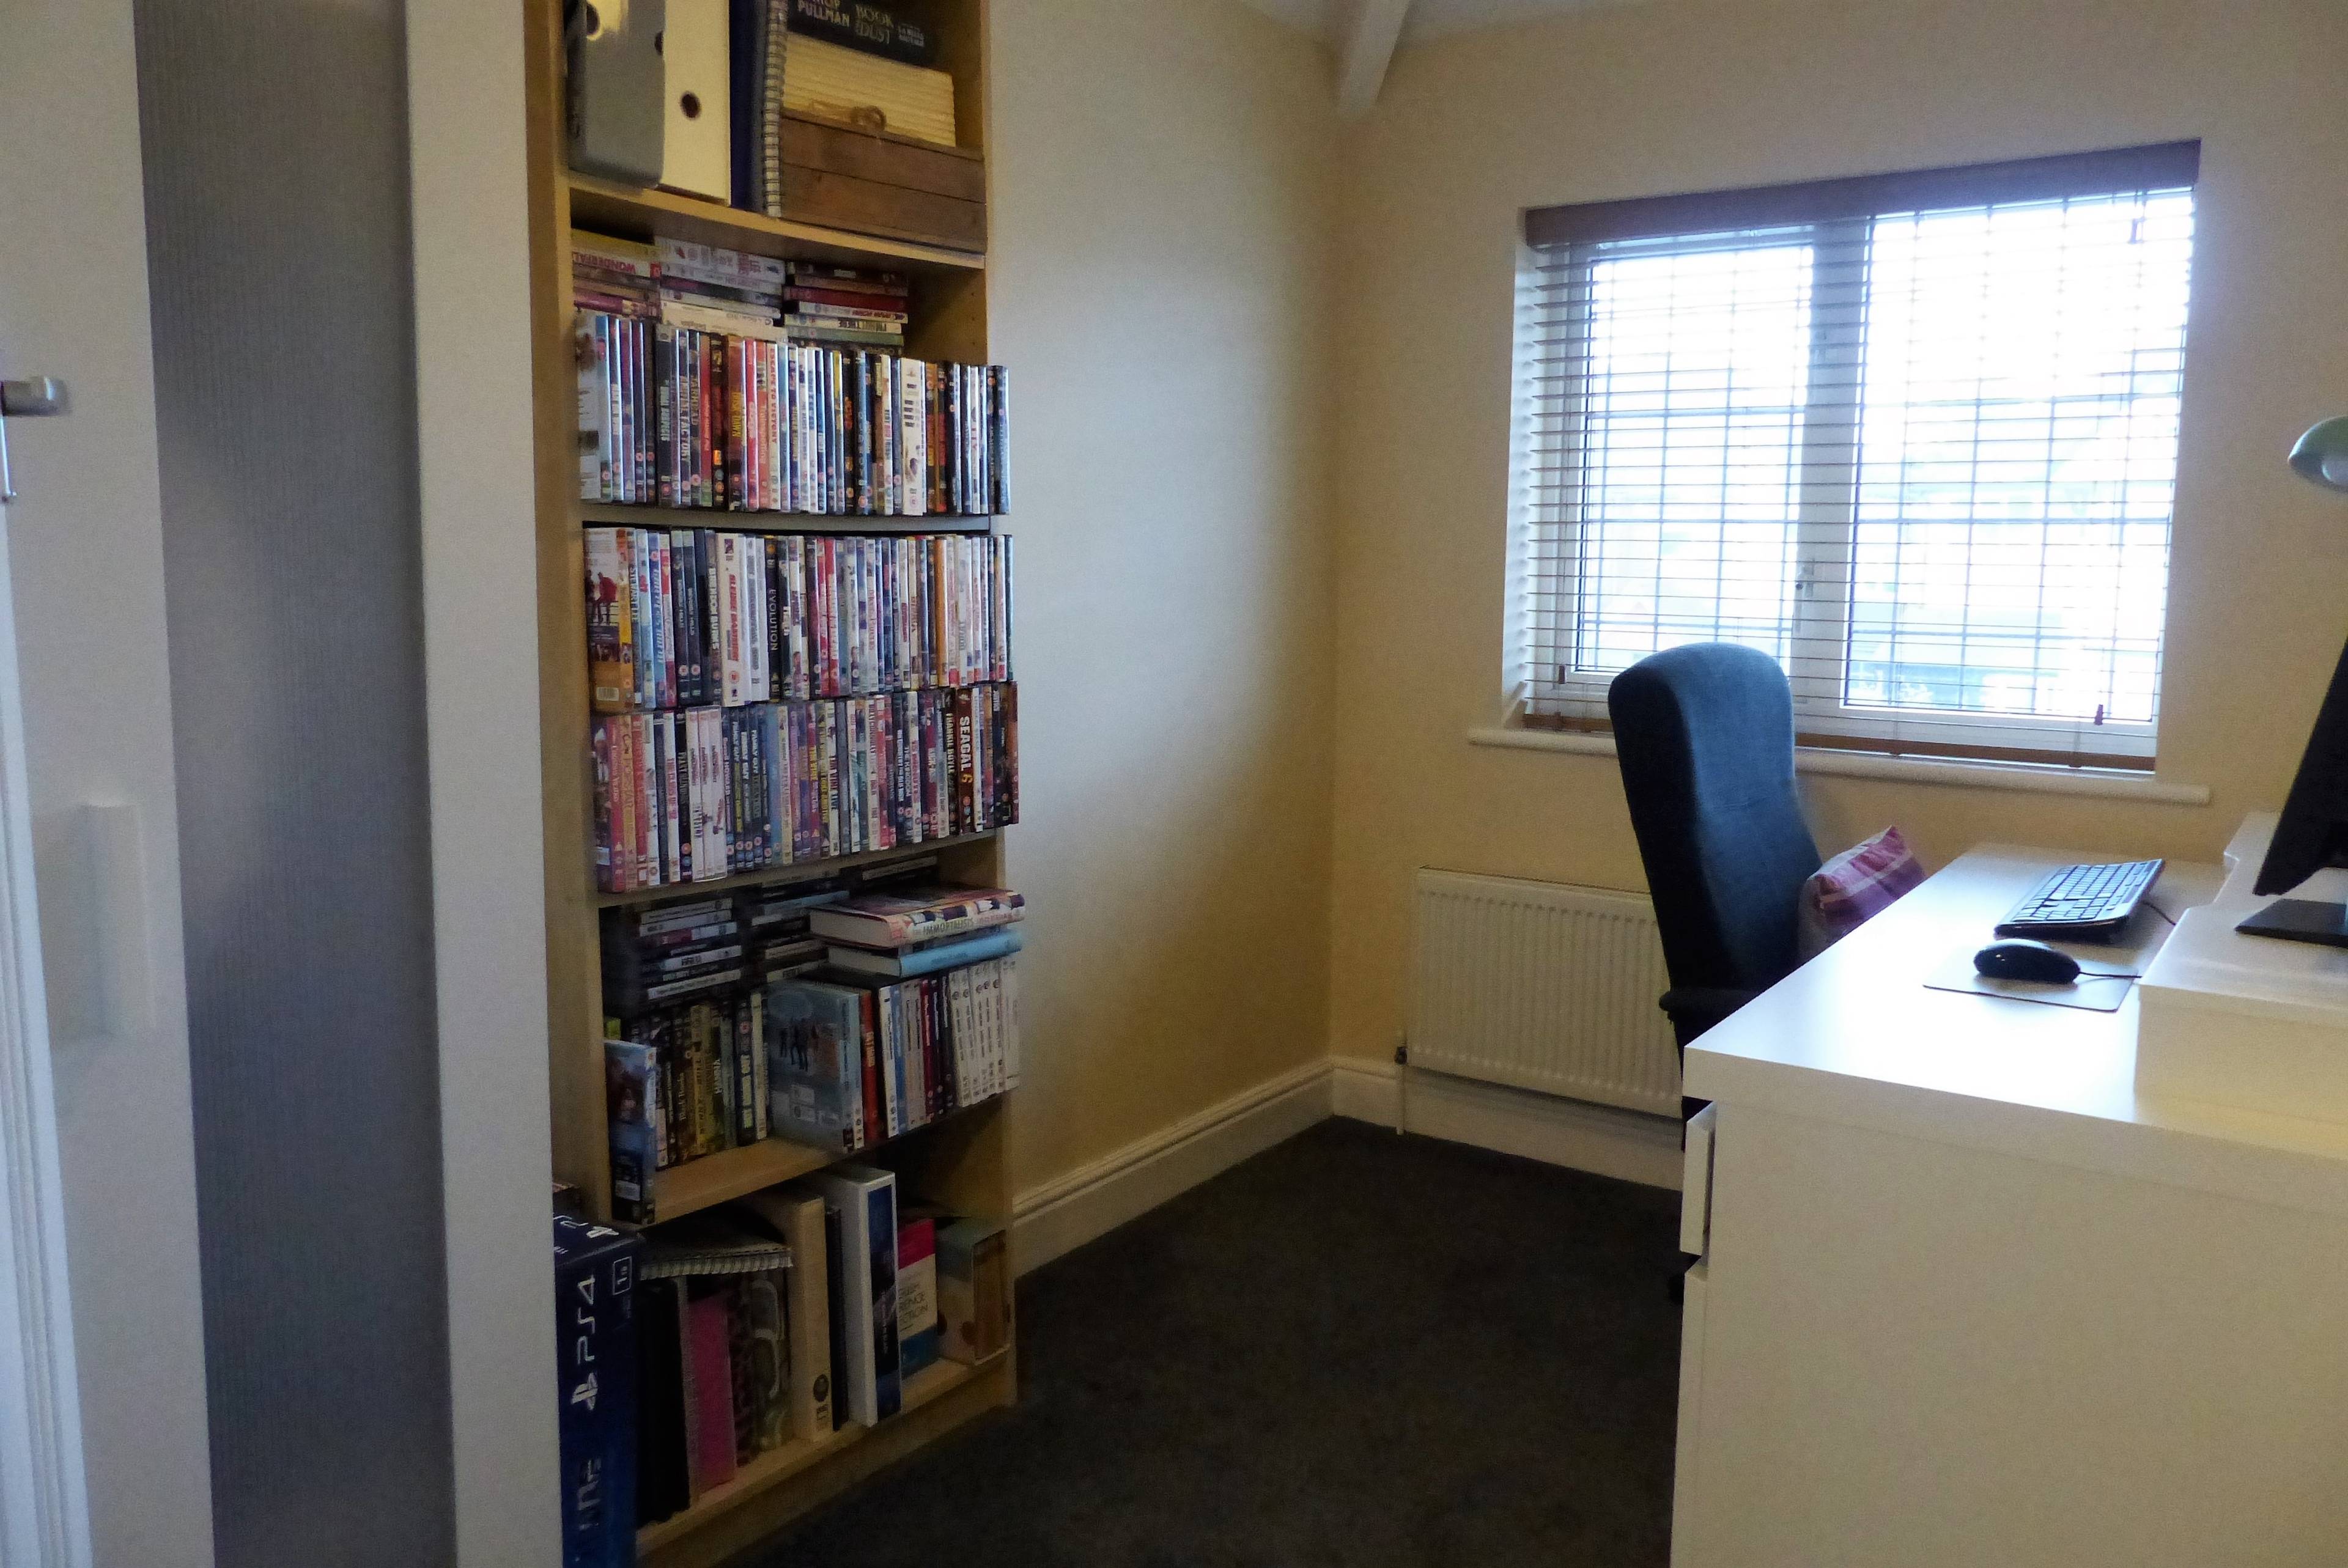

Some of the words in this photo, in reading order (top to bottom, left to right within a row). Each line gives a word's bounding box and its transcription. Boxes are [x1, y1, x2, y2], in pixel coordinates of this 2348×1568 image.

[797, 2, 850, 28] PULLMAN
[681, 416, 690, 462] FACTORY
[732, 416, 742, 438] DAWN
[768, 588, 778, 651] EVOLUTION
[947, 749, 955, 774] BOYLE
[959, 716, 972, 771] SEAGAL
[962, 773, 973, 783] 6
[577, 1274, 596, 1366] PS4
